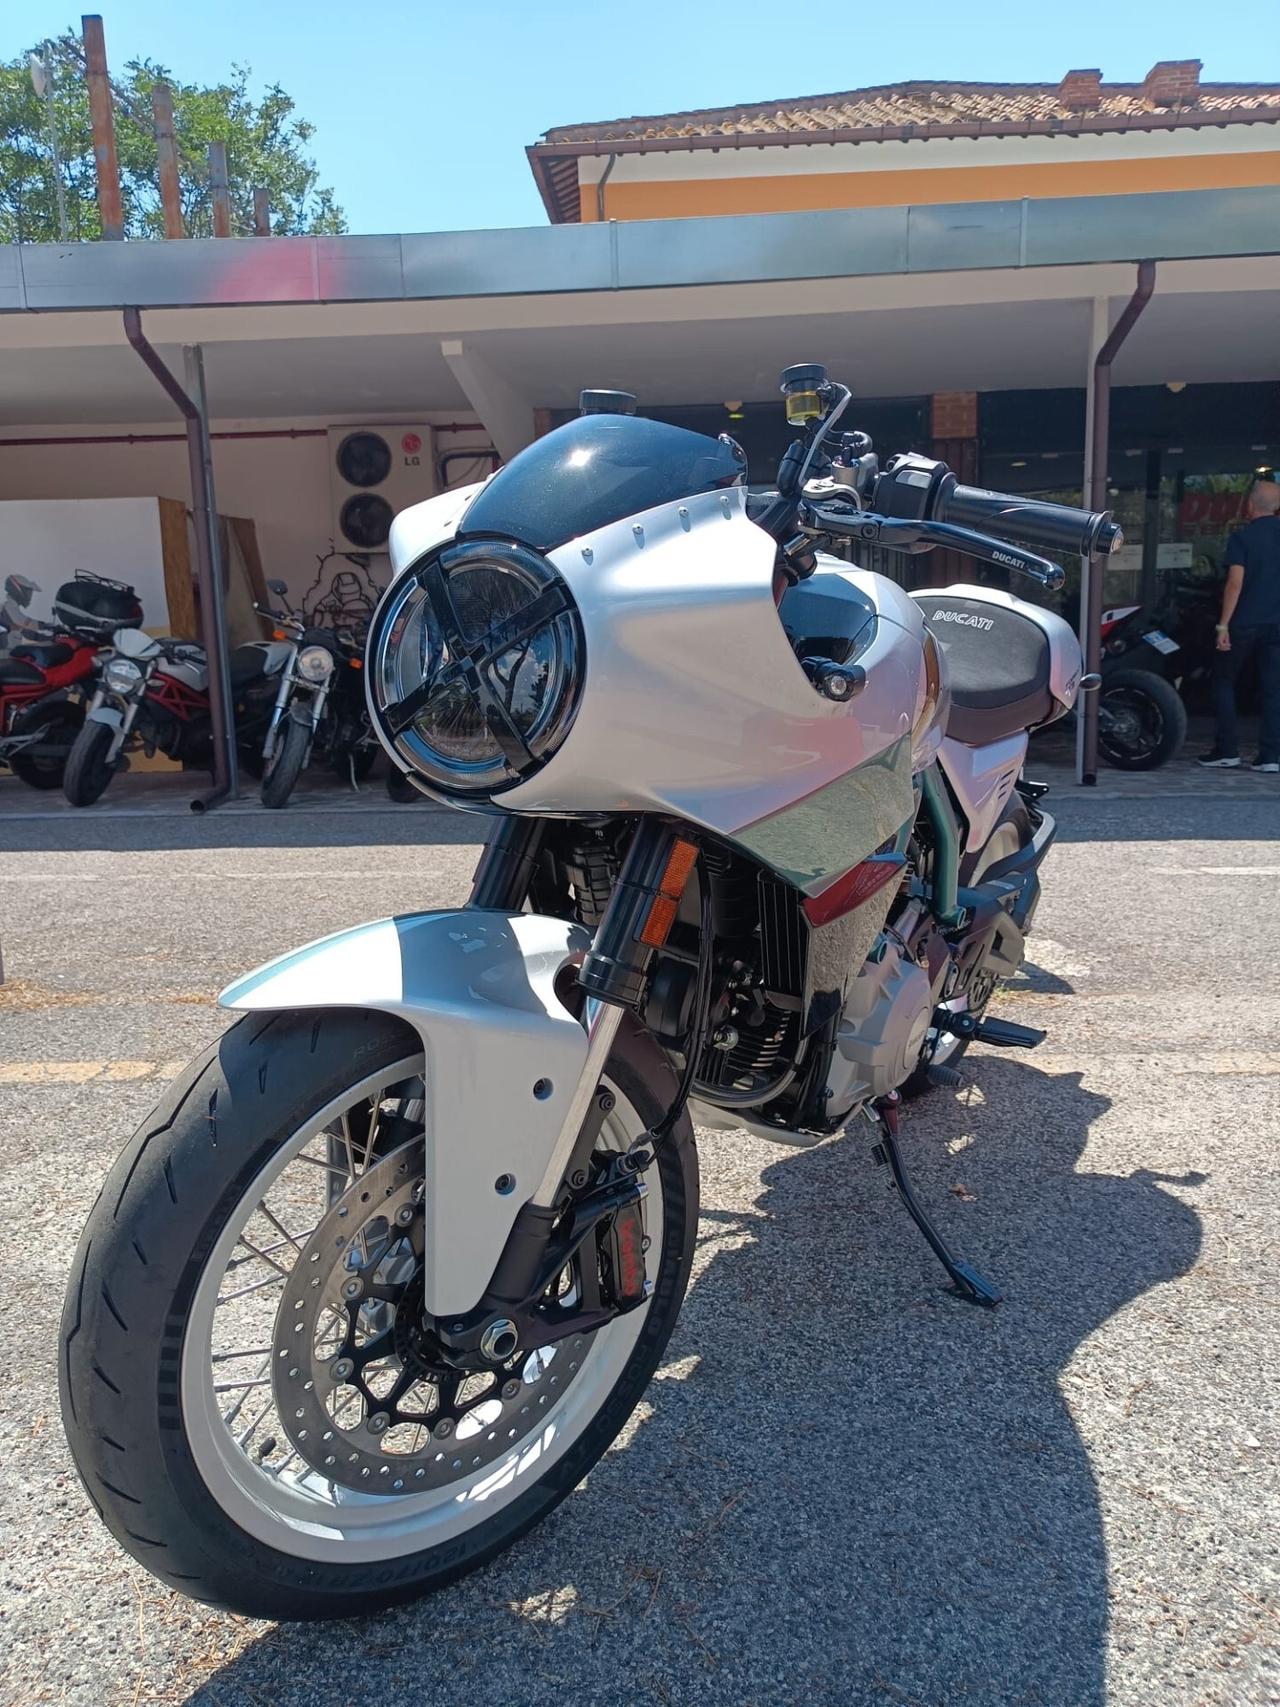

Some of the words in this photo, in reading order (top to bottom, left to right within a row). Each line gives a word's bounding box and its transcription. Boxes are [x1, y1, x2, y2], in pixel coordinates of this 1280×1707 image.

[404, 457, 420, 466] LG
[991, 550, 1026, 570] DUCATI
[932, 609, 994, 632] DUCATI
